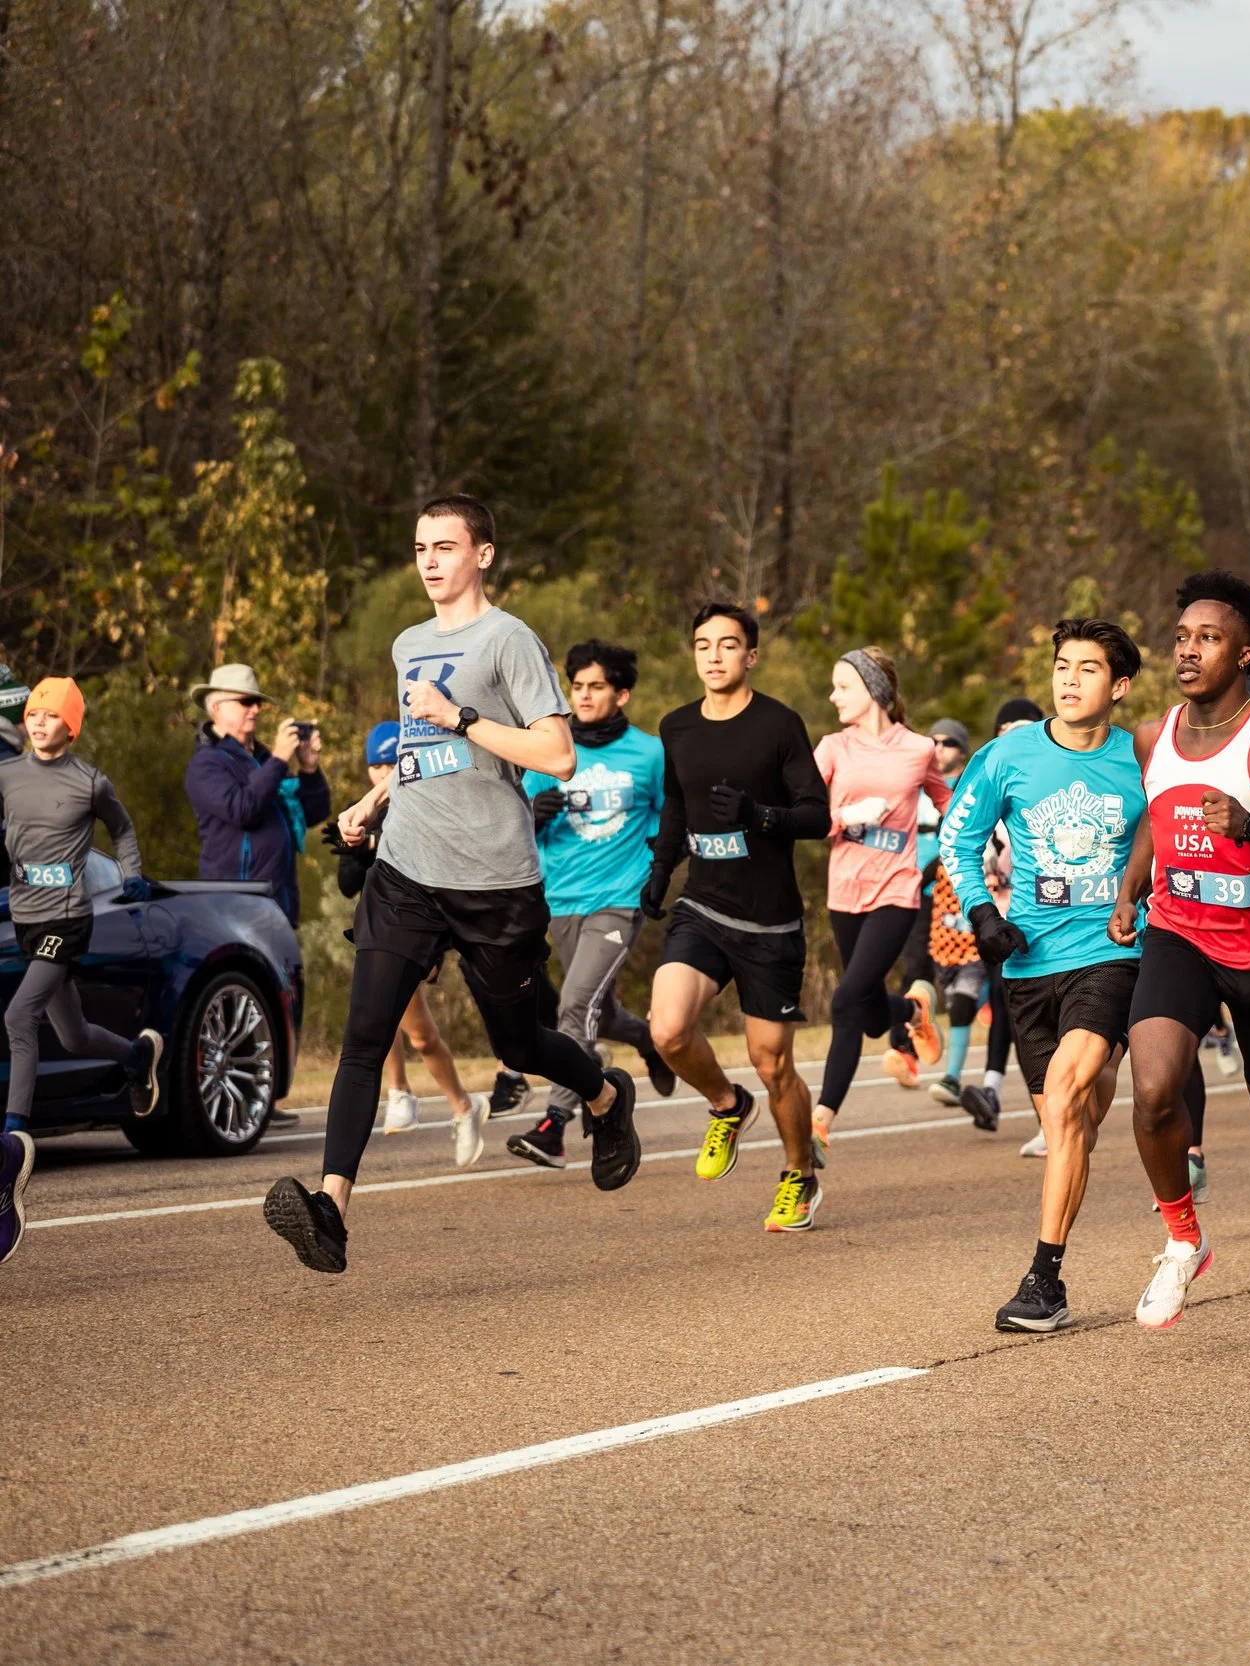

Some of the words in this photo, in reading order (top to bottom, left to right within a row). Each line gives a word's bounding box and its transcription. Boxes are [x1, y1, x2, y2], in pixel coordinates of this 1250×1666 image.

[425, 745, 459, 773] 114
[603, 790, 622, 808] 15
[1021, 788, 1070, 836] Sugar
[702, 836, 740, 856] 284
[874, 829, 900, 850] 113
[1174, 833, 1215, 852] USA
[31, 866, 66, 885] 263
[1080, 876, 1119, 903] 241
[1214, 877, 1245, 904] 39
[37, 935, 63, 958] H
